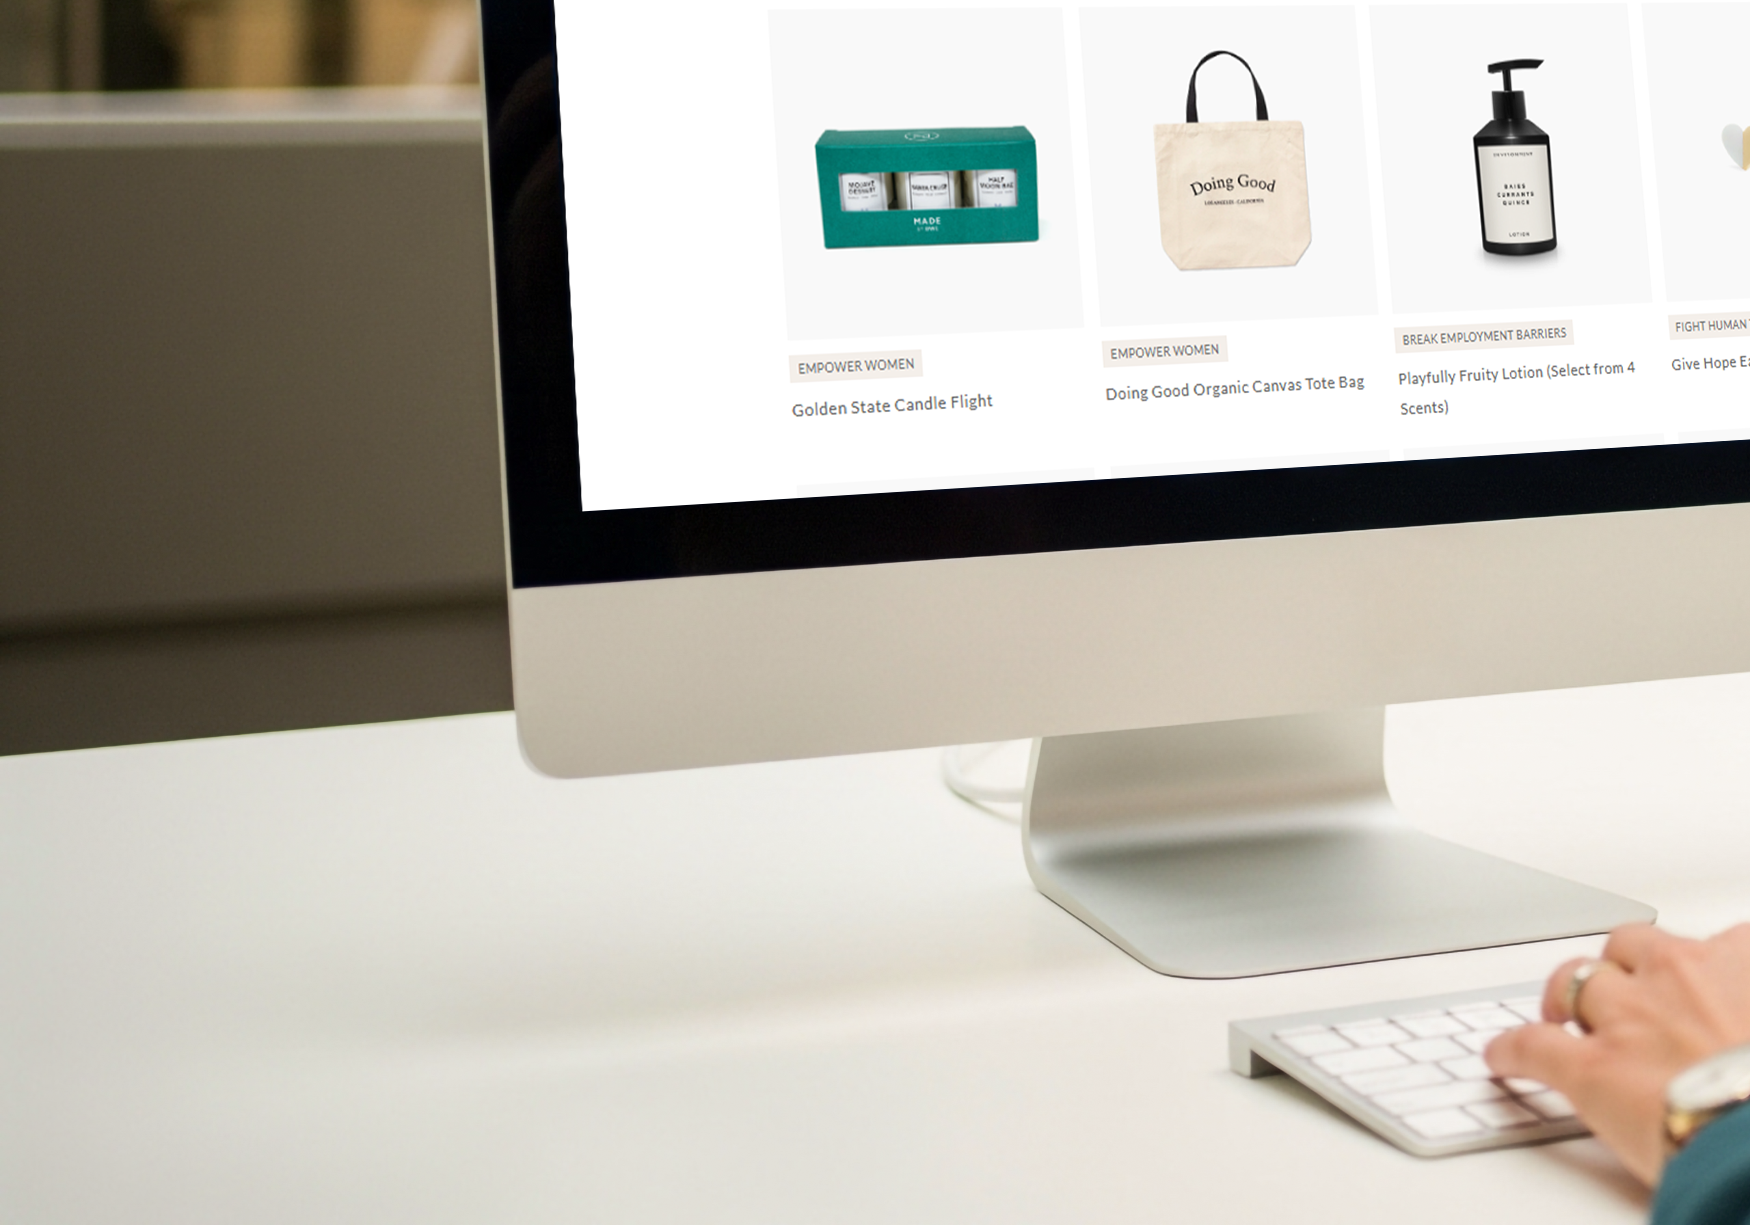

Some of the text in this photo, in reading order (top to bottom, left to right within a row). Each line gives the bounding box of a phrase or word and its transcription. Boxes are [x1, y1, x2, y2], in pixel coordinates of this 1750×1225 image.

[1190, 173, 1276, 197] Doing Good
[913, 216, 941, 226] MADE
[1675, 320, 1706, 332] FIGHT
[1708, 319, 1747, 331] HUMAN
[1402, 327, 1567, 346] BREAK EMPLOYMENT BARRIERS
[1110, 343, 1219, 360] EMPOWER WOMEN
[798, 357, 915, 375] EMPOWER WOMEN
[1671, 356, 1700, 372] Give
[1703, 357, 1737, 371] Hope
[1398, 361, 1636, 387] Playfully Fruity Lotion (Select from 4
[1105, 375, 1365, 402] Doing Good Organic Canvas Tote Bag
[791, 393, 993, 418] Golden State Candle Flight
[1400, 399, 1449, 416] Scents)
